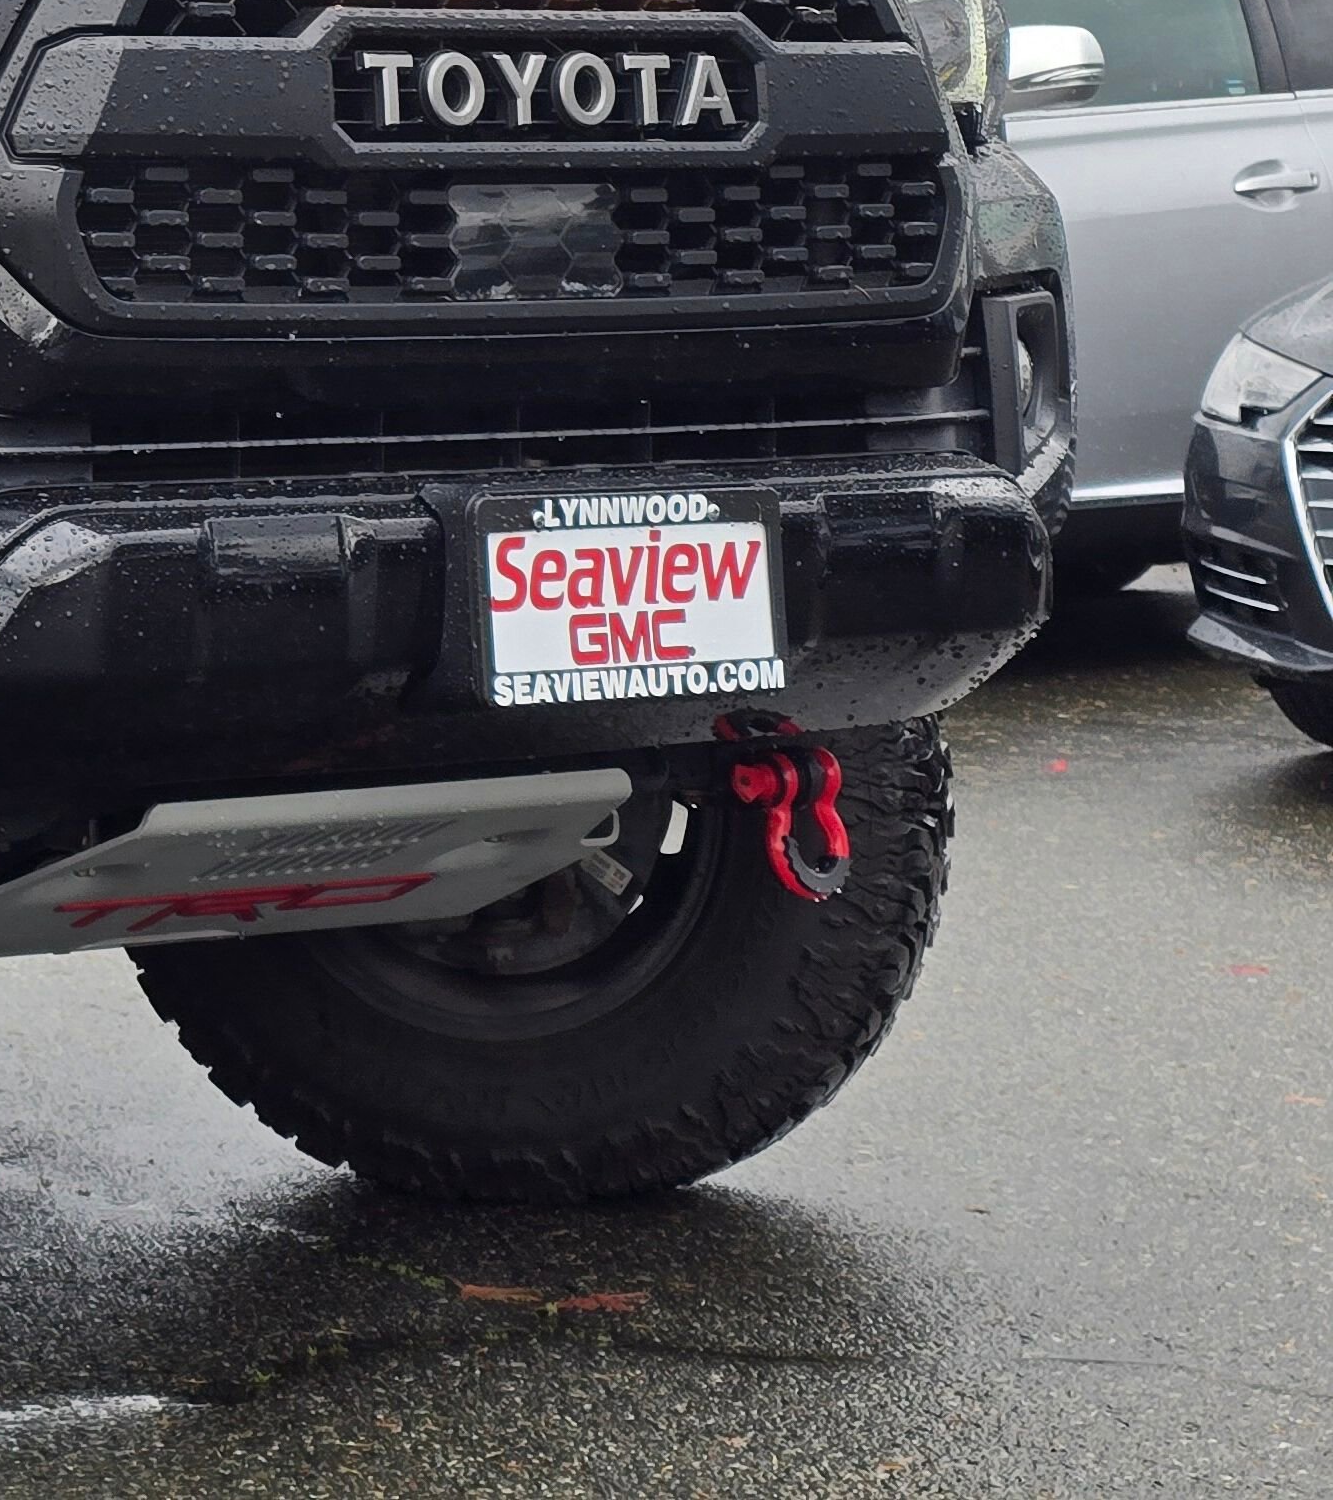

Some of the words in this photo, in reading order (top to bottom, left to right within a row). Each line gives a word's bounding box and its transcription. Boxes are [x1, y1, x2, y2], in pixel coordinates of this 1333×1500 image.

[360, 50, 737, 128] TOYOTA
[543, 494, 709, 528] LYNNWOOD
[490, 529, 762, 613] Seaview
[569, 608, 689, 666] GMC
[493, 658, 786, 706] SEAVIEWAUTO.COM
